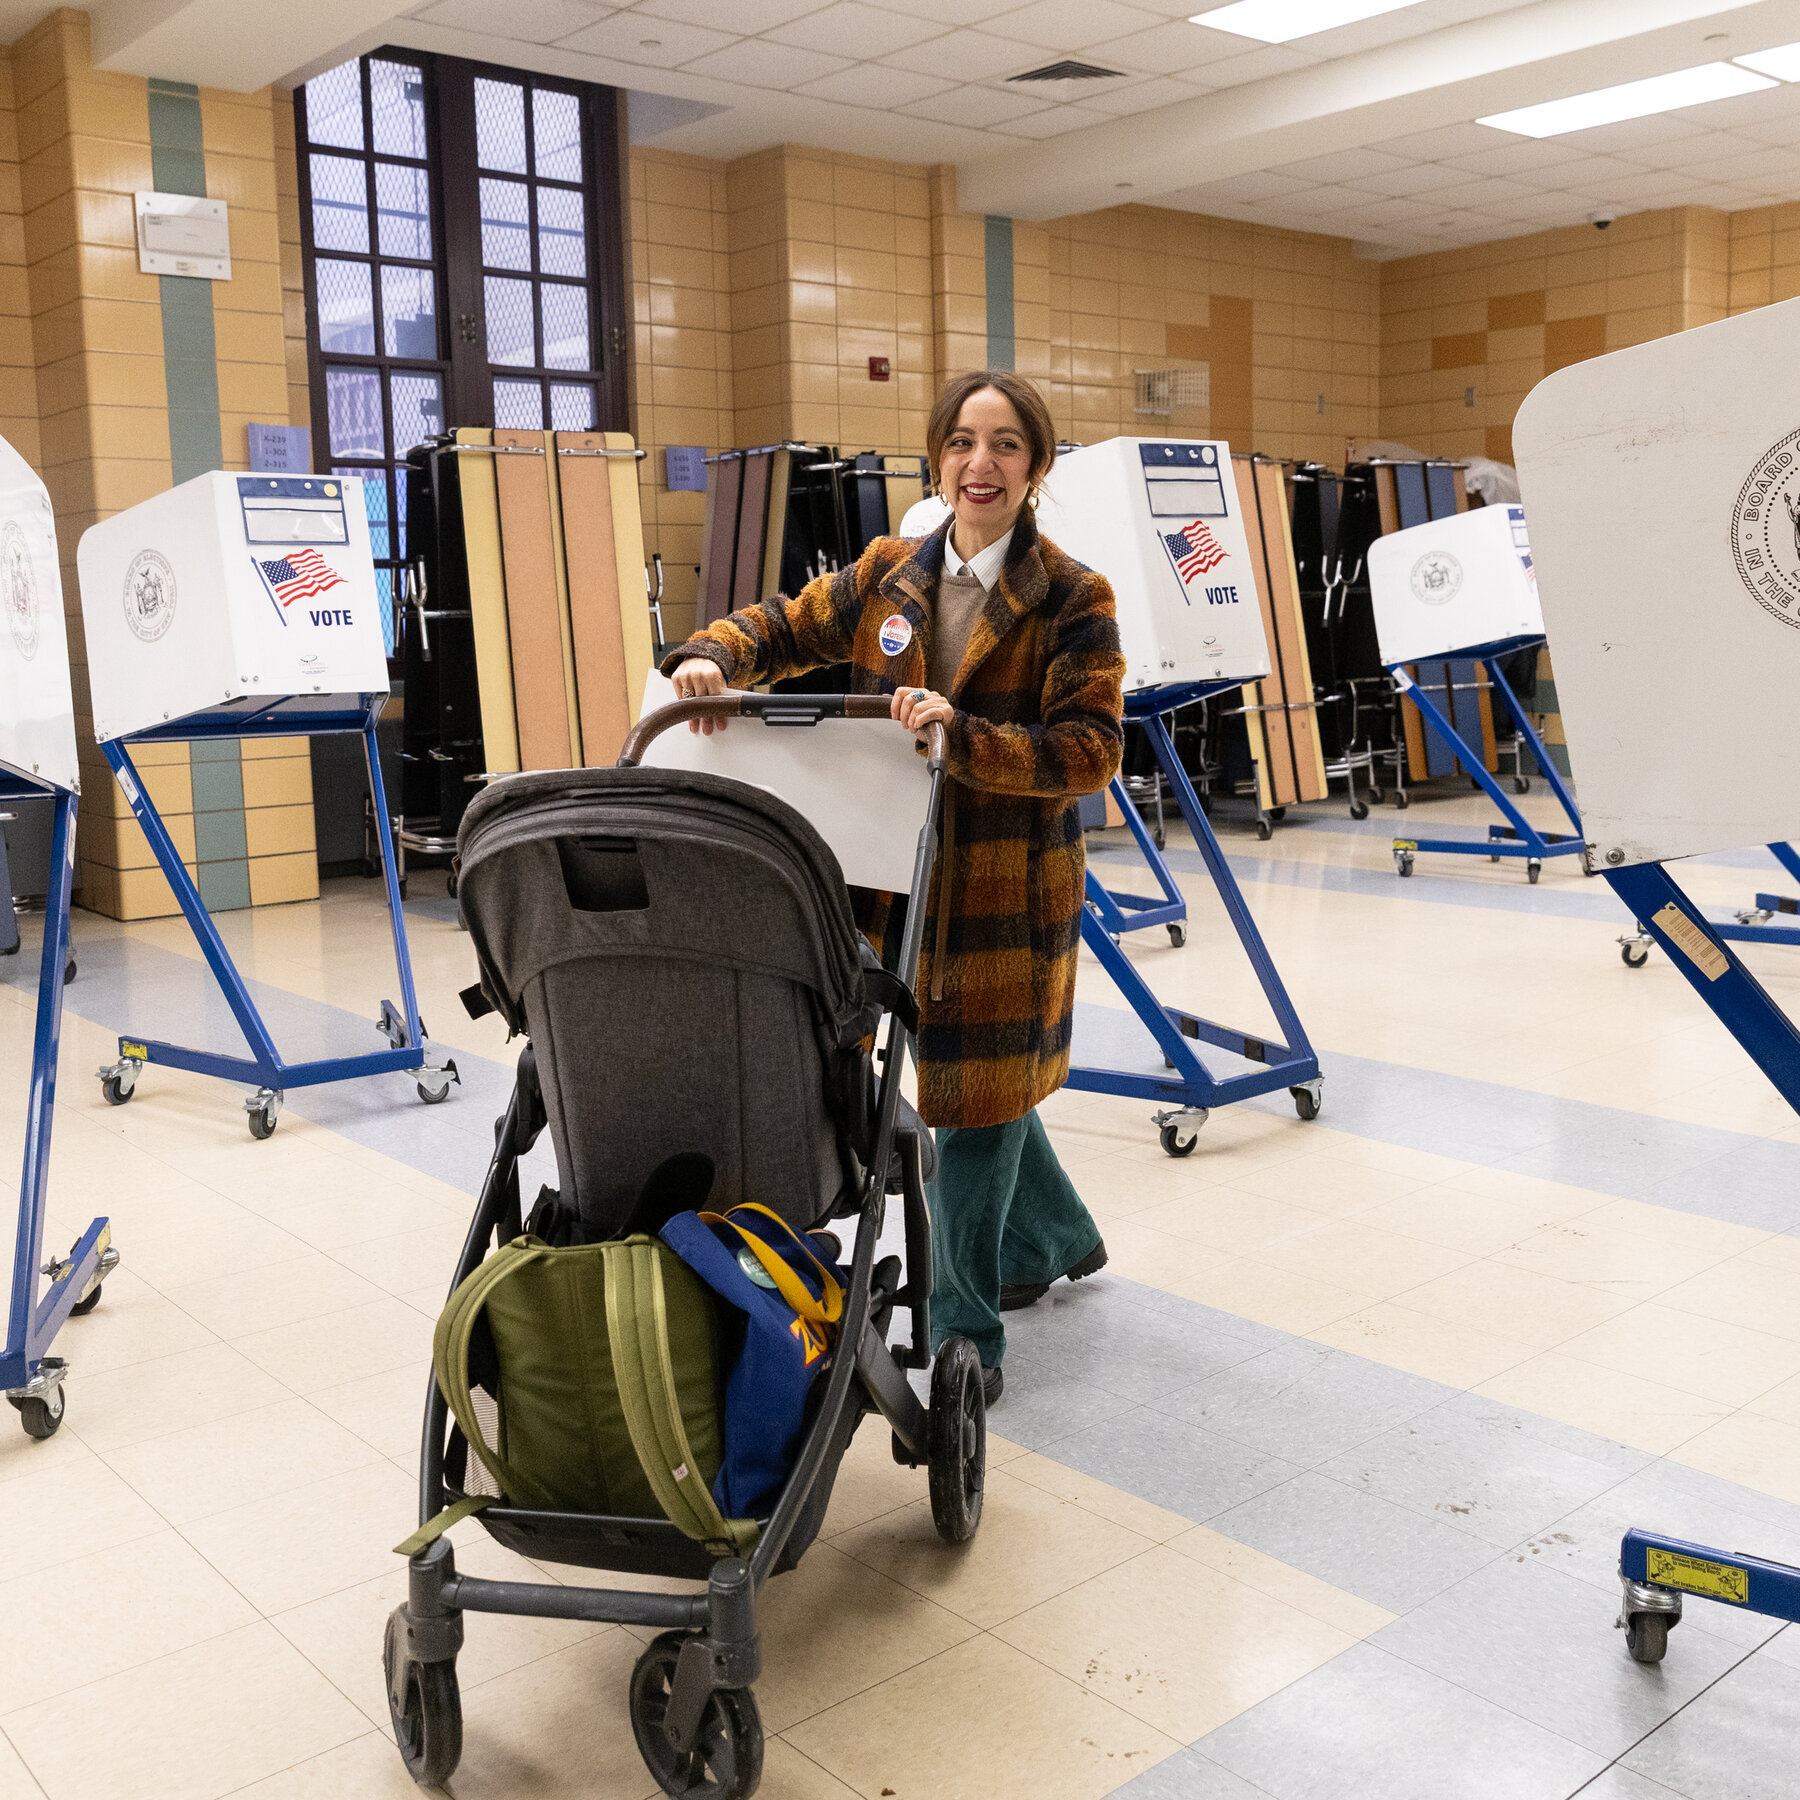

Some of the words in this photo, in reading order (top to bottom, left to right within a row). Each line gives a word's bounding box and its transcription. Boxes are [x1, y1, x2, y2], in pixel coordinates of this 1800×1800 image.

[1743, 452, 1793, 522] BOARD
[1205, 586, 1239, 605] VOTE
[1744, 547, 1765, 571] IN
[1757, 571, 1795, 609] THE
[309, 609, 353, 626] VOTE
